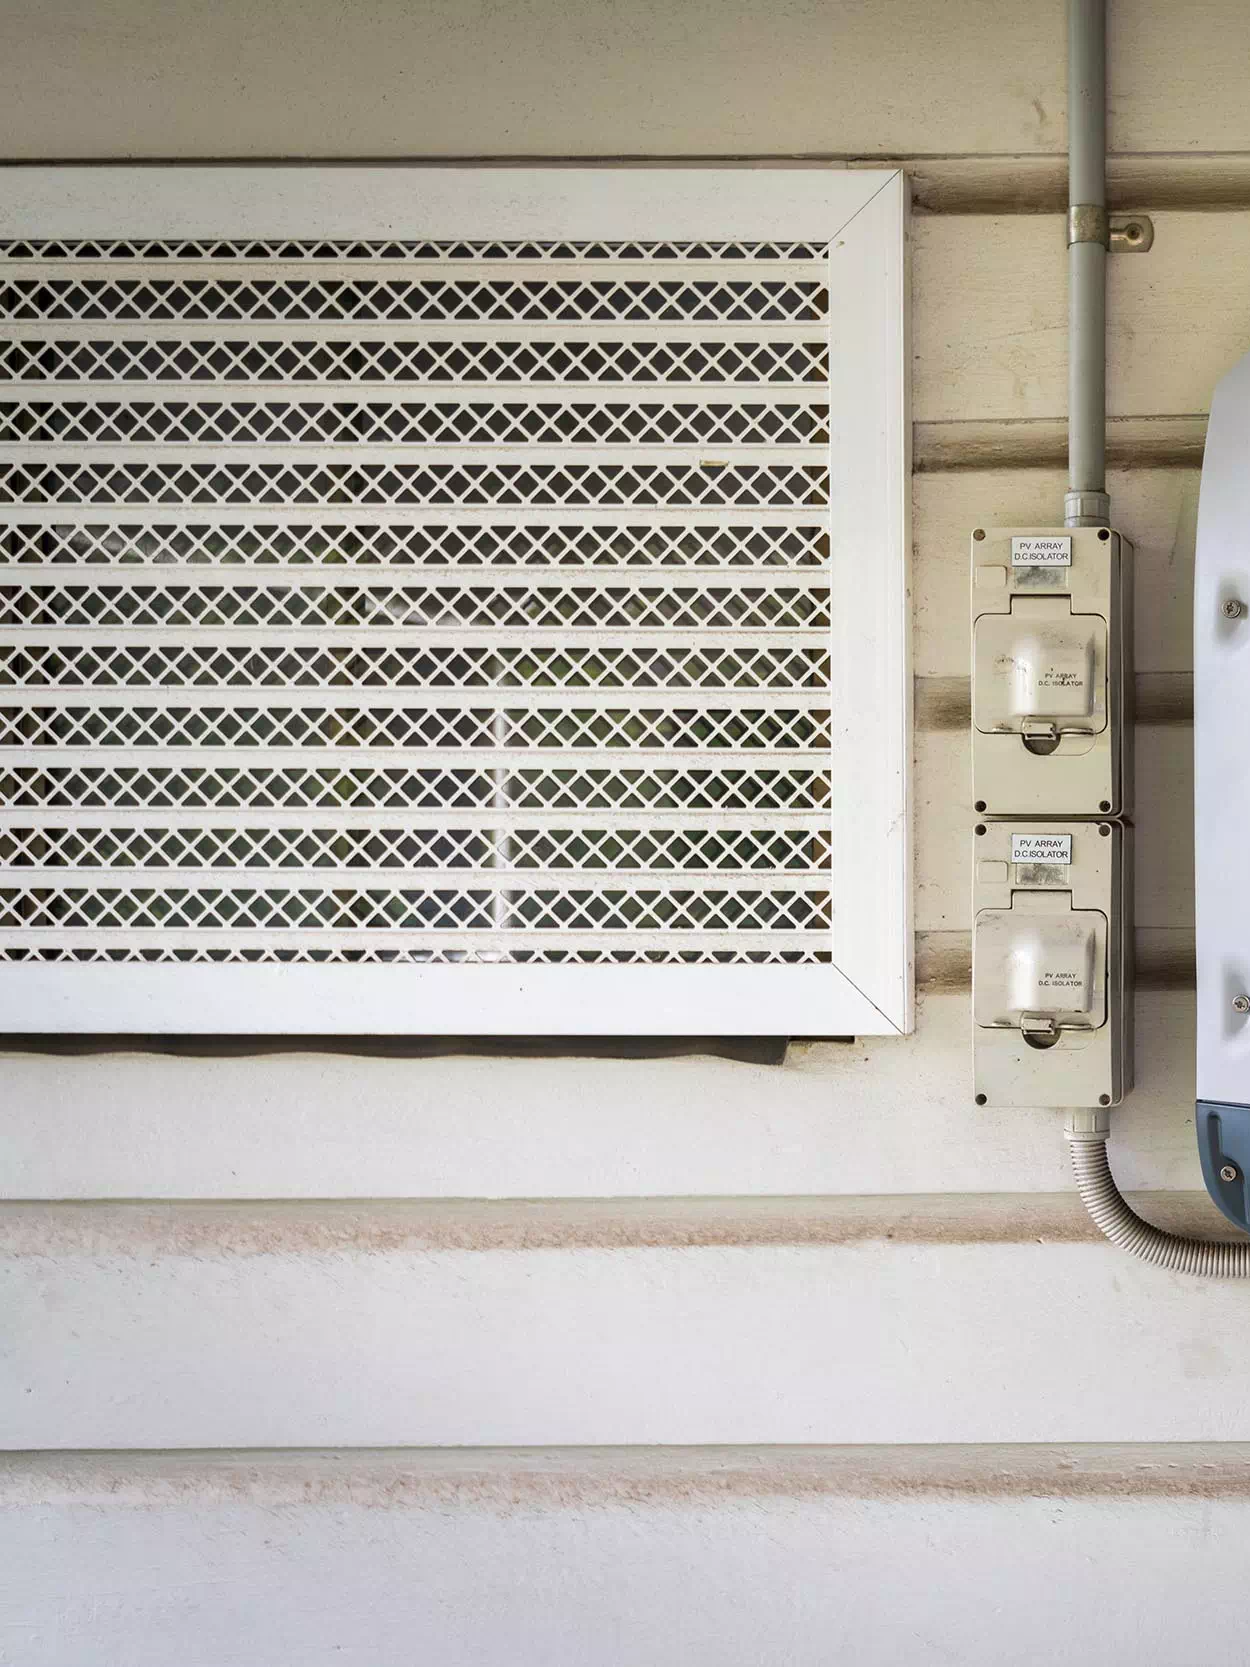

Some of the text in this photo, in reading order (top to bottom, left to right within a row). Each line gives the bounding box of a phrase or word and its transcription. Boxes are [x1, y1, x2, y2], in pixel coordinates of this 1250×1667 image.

[1019, 542, 1064, 550] PV ARRAY
[1019, 839, 1063, 848] PV ARRAY
